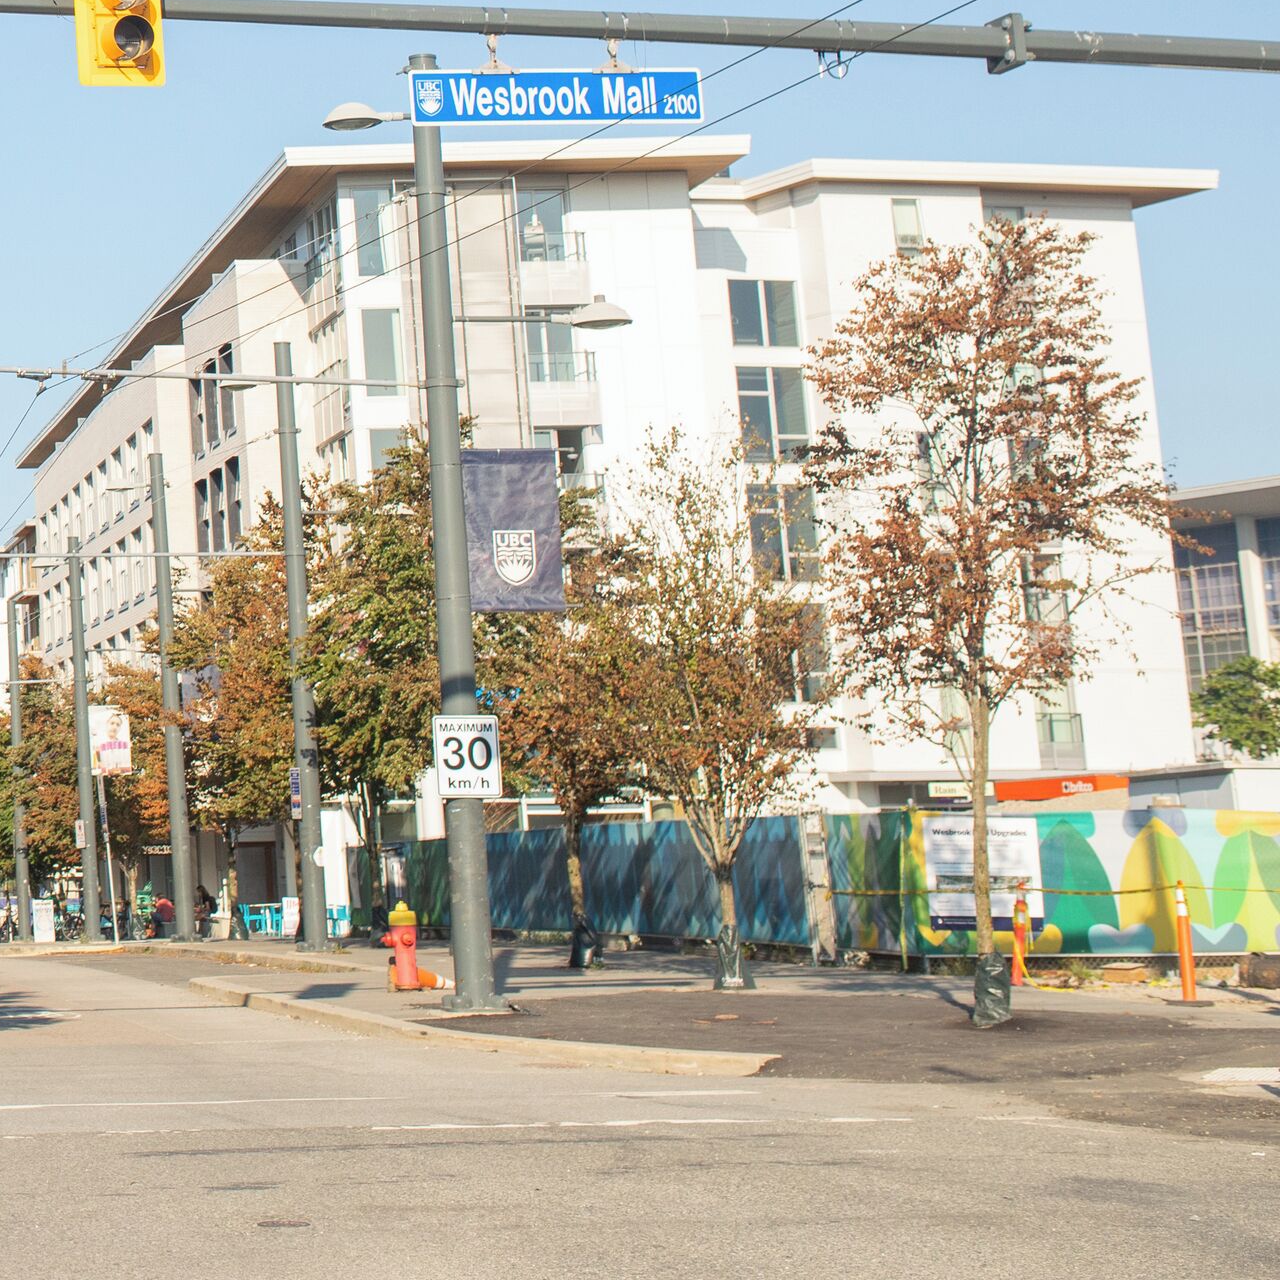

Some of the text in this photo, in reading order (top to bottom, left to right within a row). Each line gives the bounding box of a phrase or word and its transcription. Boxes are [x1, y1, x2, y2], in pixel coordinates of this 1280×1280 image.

[449, 76, 697, 117] Wesbrook Mall 2100
[496, 533, 531, 547] UBC
[439, 723, 493, 732] MAXIMUM
[443, 736, 493, 771] 30
[448, 776, 490, 789] km/h
[932, 828, 971, 836] Wesbrook
[990, 829, 1028, 838] Upgrades
